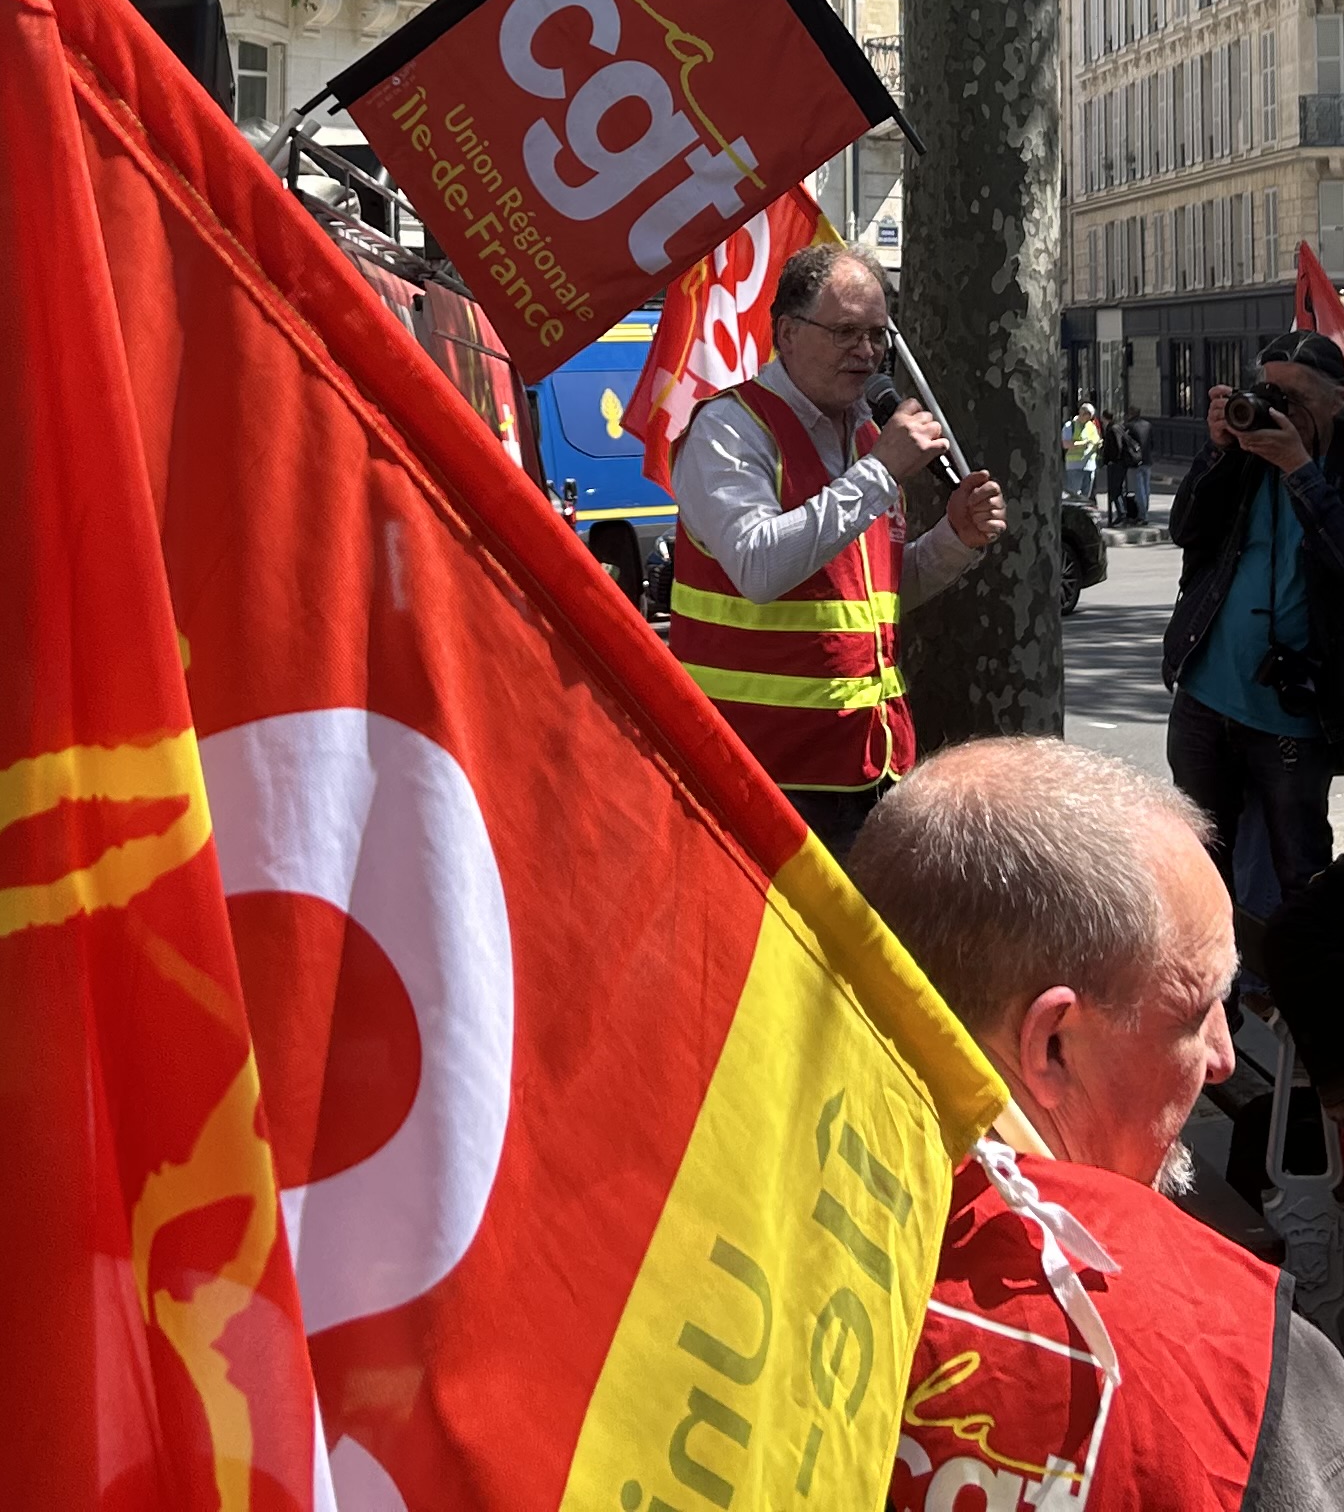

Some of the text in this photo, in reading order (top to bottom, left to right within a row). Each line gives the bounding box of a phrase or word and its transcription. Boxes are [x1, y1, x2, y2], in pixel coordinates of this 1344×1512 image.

[392, 86, 565, 348] Île-de-France
[444, 102, 595, 322] Union Régionale
[904, 1350, 1085, 1482] la
